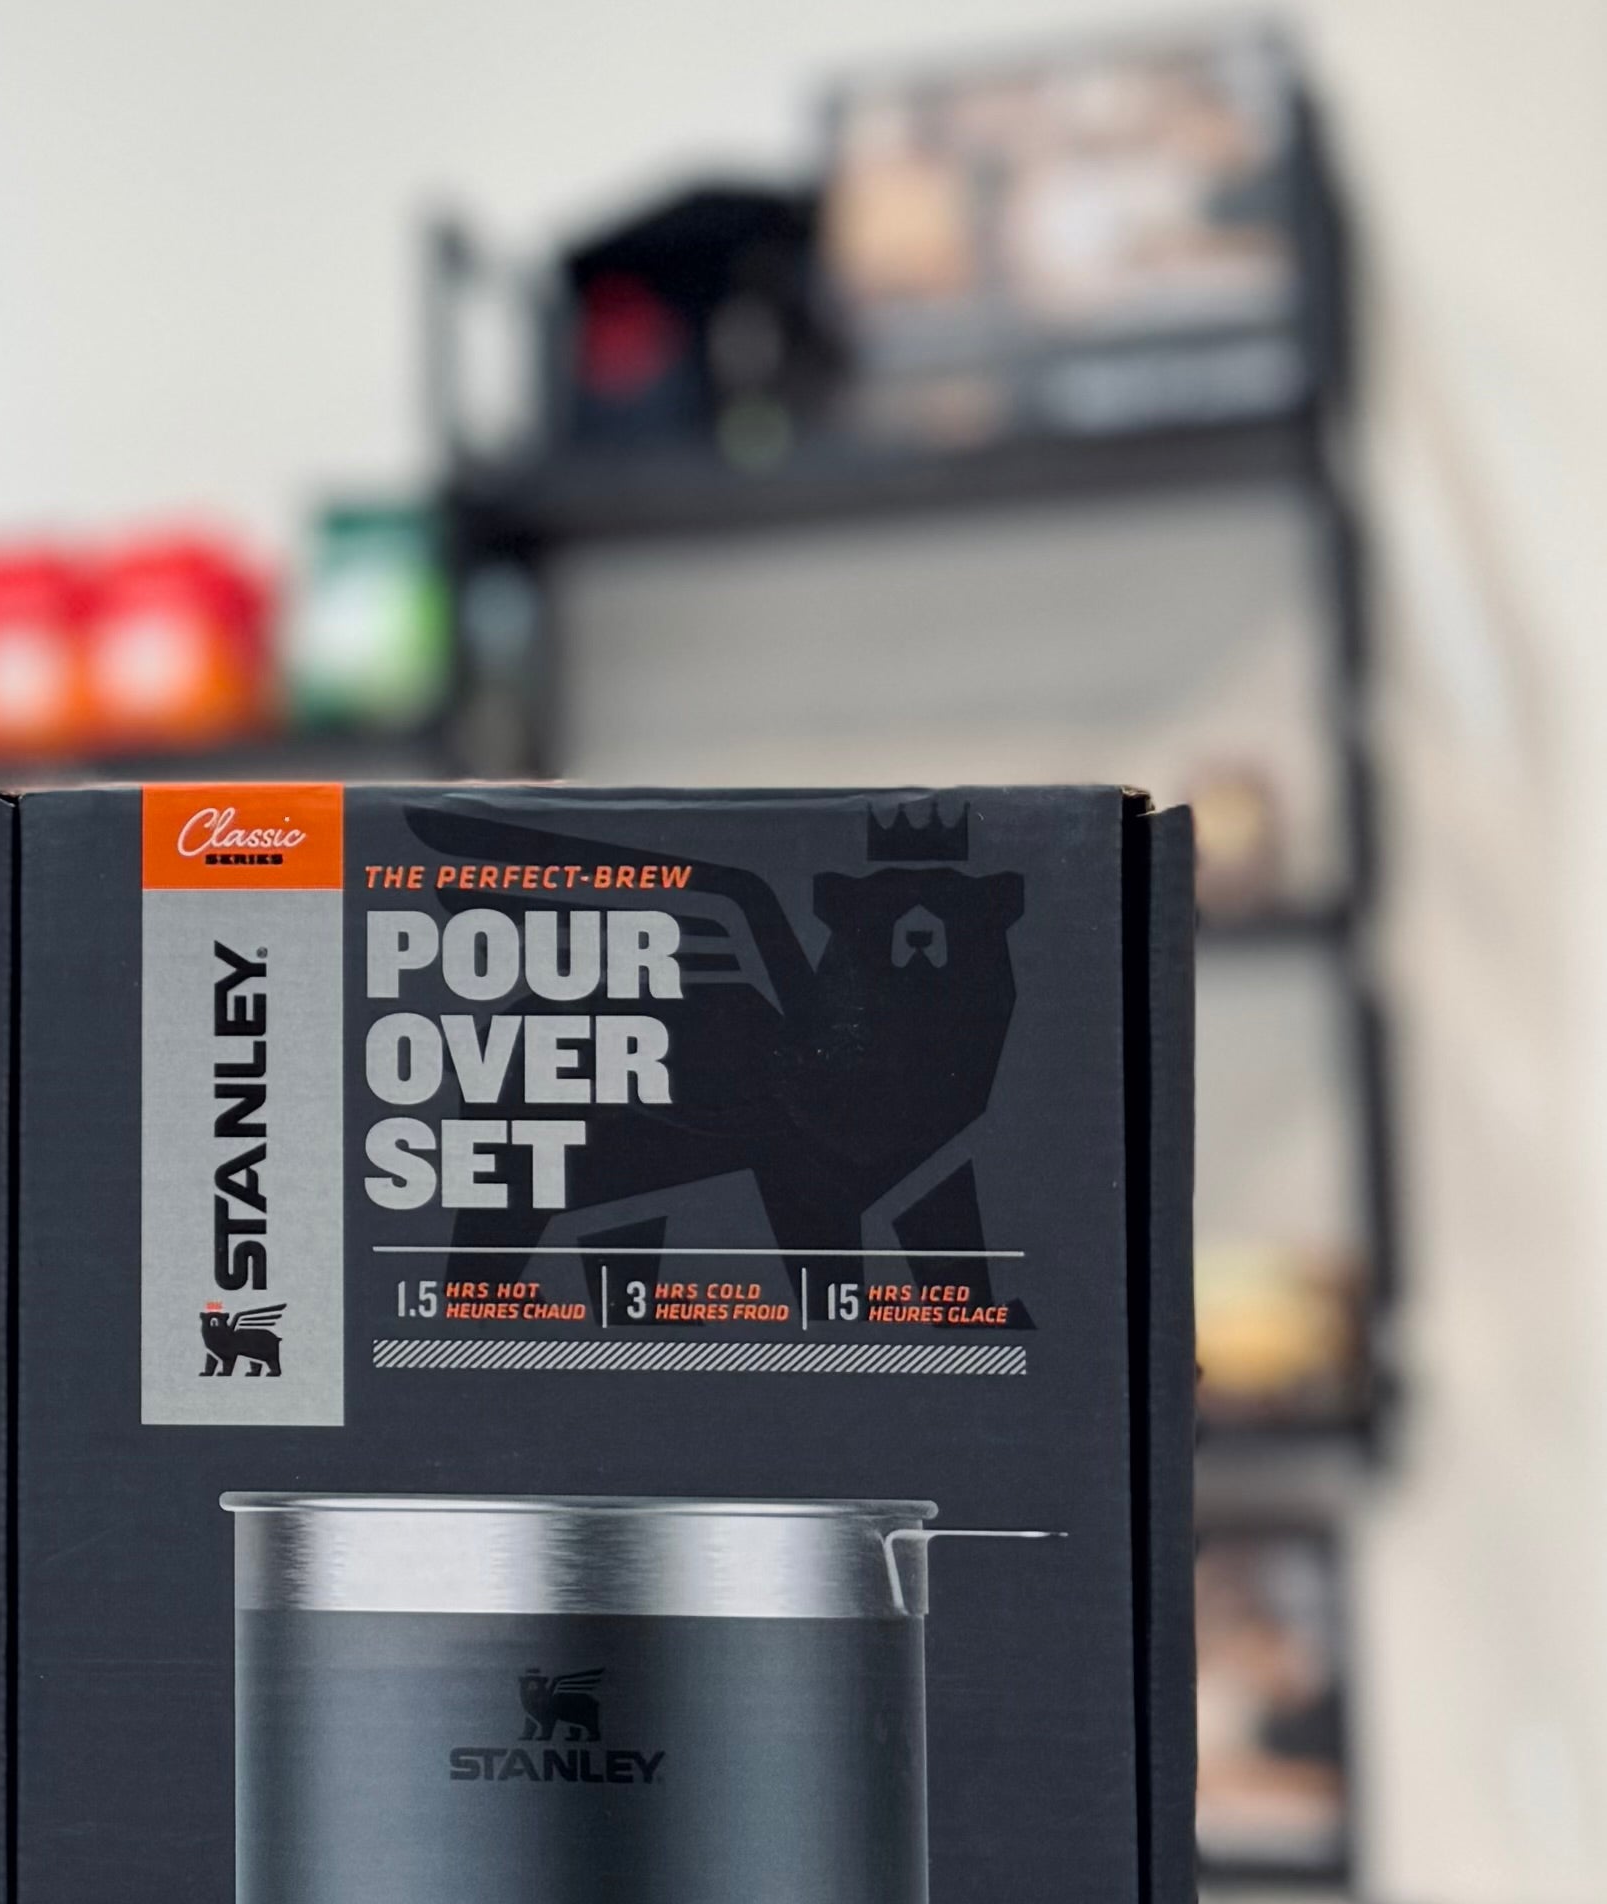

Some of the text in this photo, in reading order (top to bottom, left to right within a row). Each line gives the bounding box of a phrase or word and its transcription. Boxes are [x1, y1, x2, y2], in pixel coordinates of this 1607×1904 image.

[177, 807, 307, 857] Classic
[365, 865, 692, 889] THE PERFECT-BREW
[366, 908, 684, 1001] POUR
[365, 1012, 673, 1105] OVER
[364, 1117, 586, 1210] SET
[397, 1281, 438, 1318] 1.5
[446, 1282, 541, 1299] HRS HOT
[627, 1281, 647, 1319] 3
[655, 1283, 762, 1300] HRS COLD
[827, 1283, 859, 1321] 15
[867, 1285, 971, 1302] HRS ICED
[446, 1303, 587, 1320] HEURES CHAUD
[655, 1303, 790, 1321] HEURES FROID
[868, 1305, 943, 1323] HEURES
[449, 1747, 666, 1784] STANLEY
